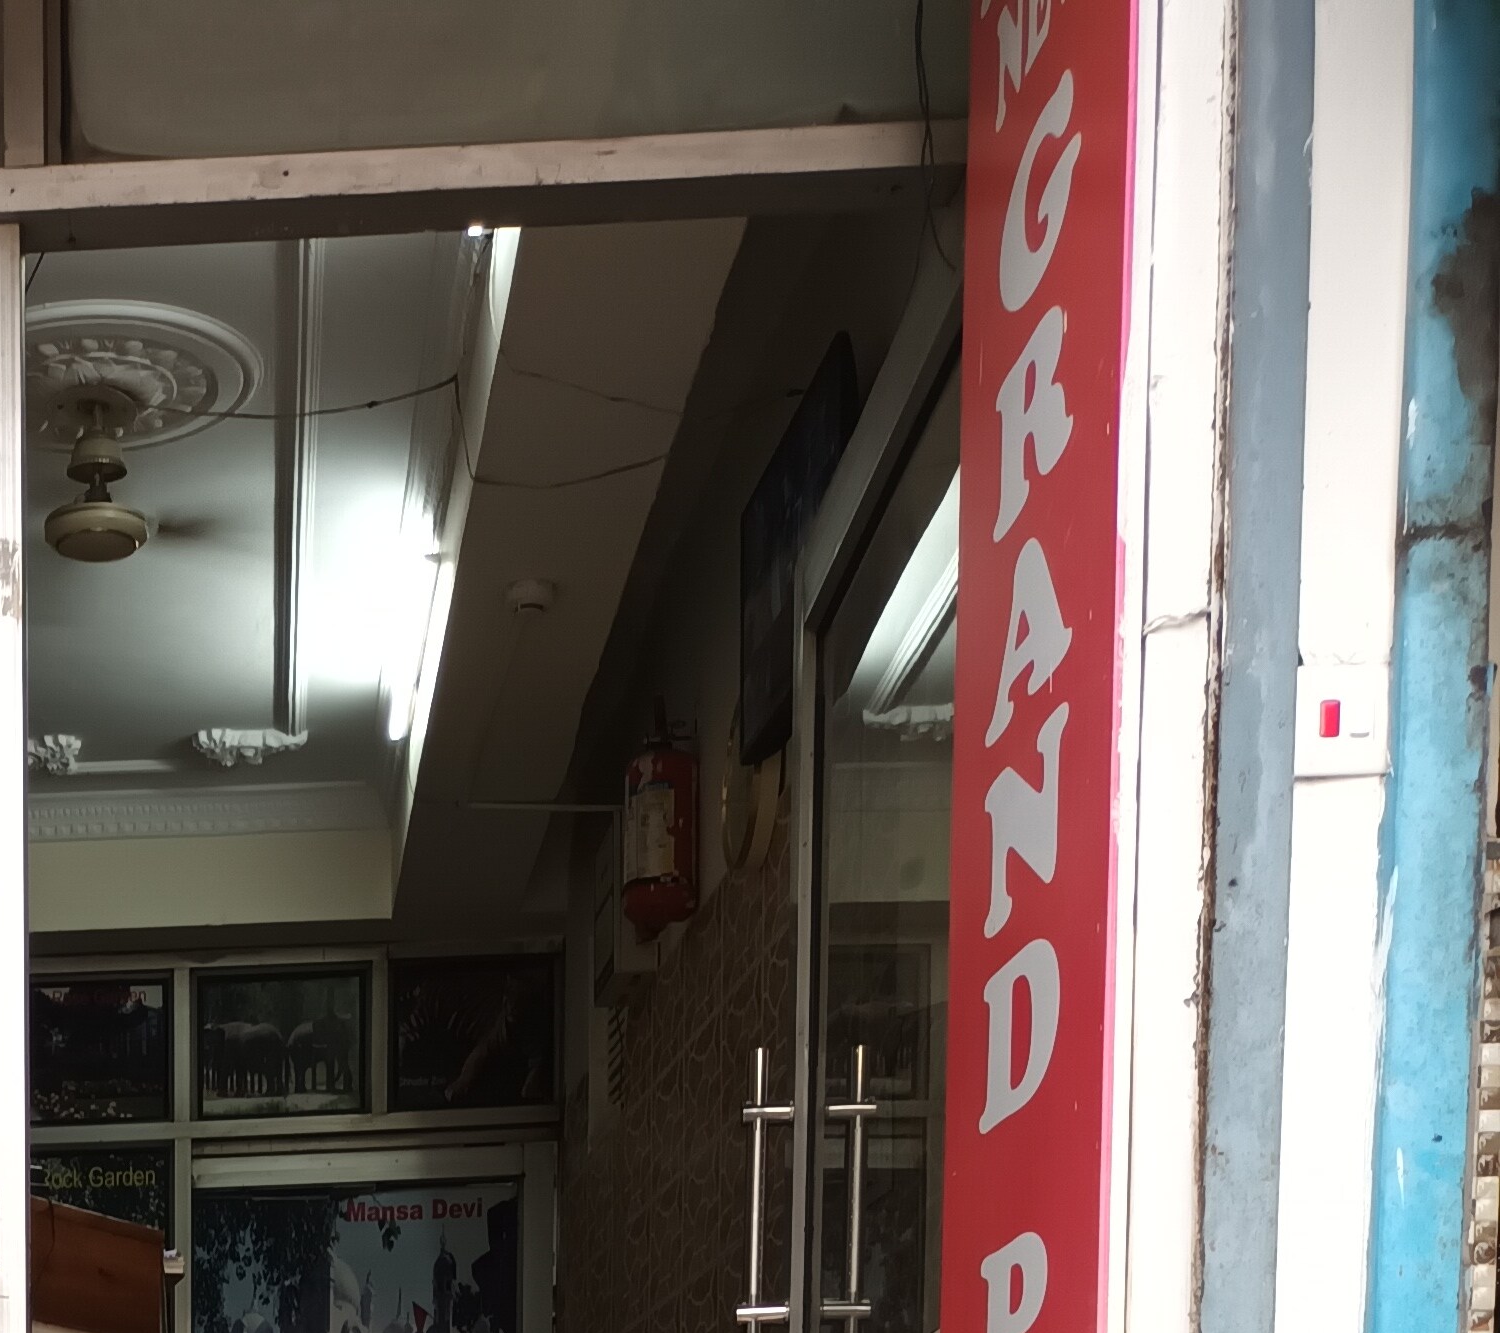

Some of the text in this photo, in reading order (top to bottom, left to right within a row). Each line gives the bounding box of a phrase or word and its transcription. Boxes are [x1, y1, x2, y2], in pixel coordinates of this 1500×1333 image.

[979, 68, 1082, 1135] GRAND
[87, 1165, 157, 1188] Garden
[345, 1196, 483, 1222] Mansa Devi
